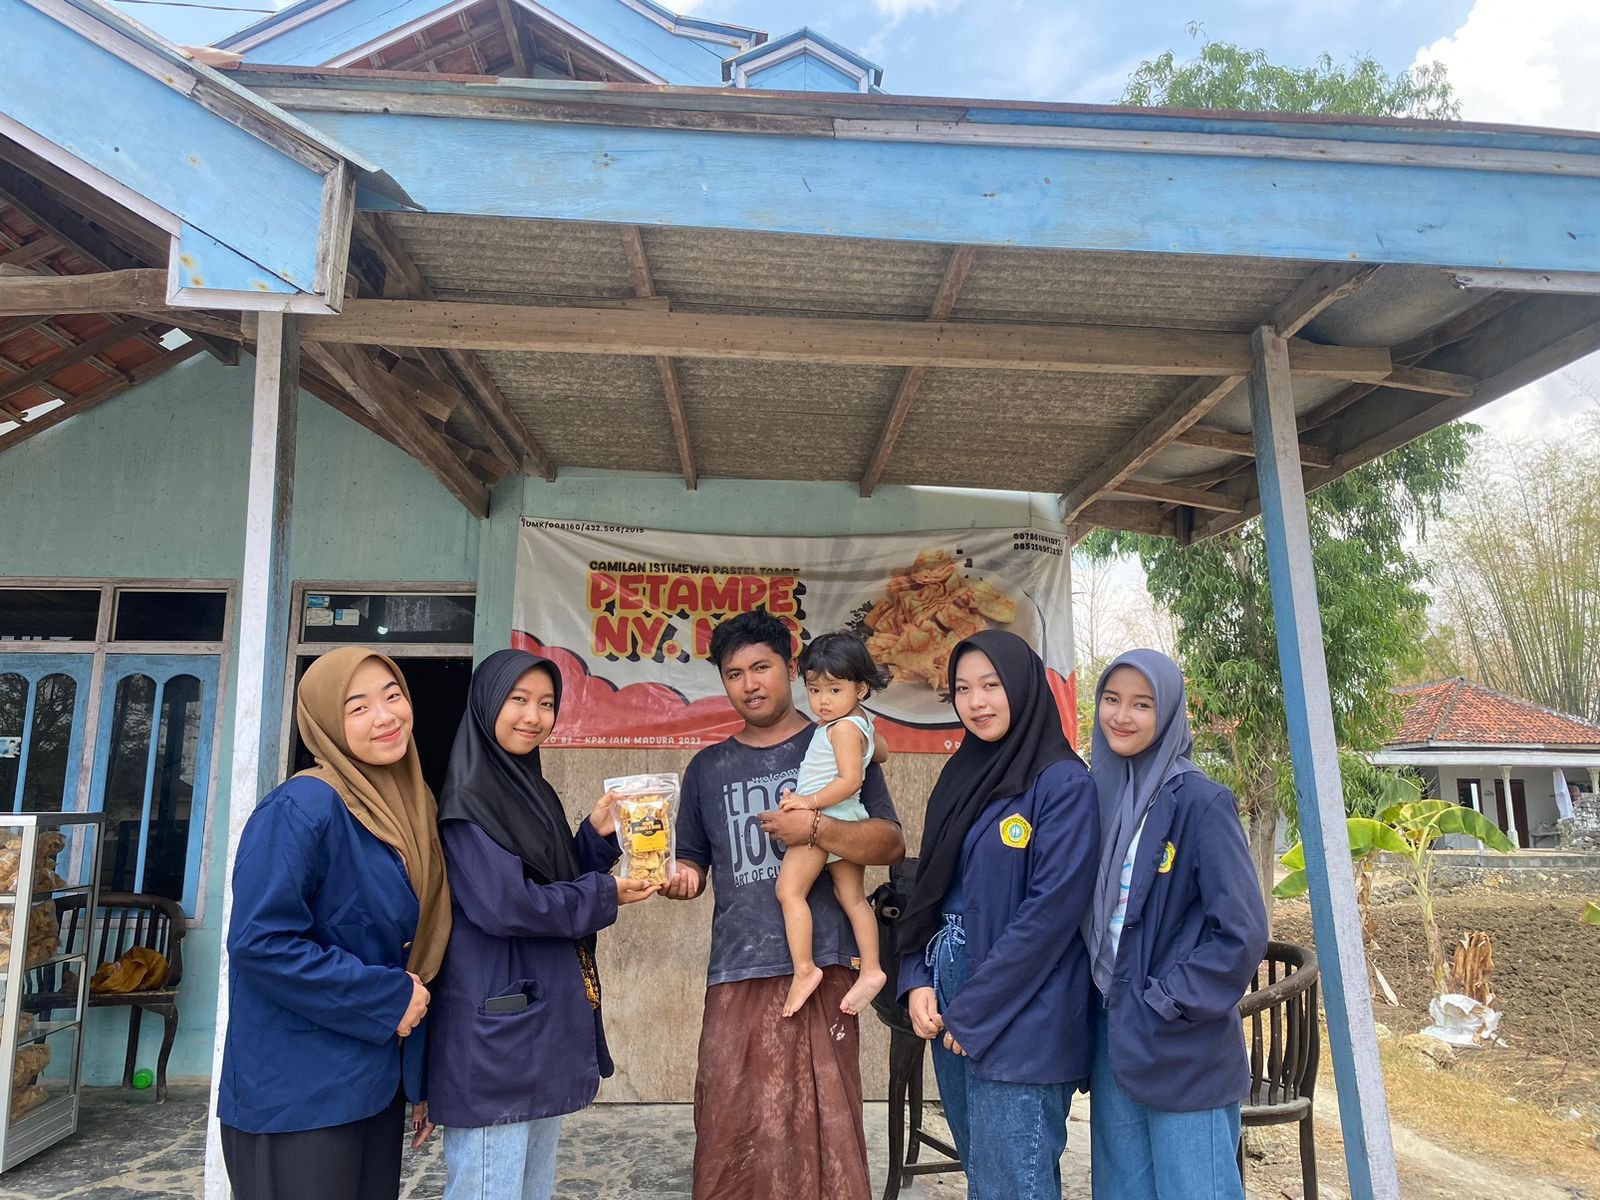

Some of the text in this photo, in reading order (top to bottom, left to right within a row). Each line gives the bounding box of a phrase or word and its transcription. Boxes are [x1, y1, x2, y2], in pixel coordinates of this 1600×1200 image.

[589, 560, 647, 572] CAMILAN
[649, 563, 710, 574] ISTIMEWA
[713, 566, 756, 575] PASTEL
[589, 572, 796, 612] PETAMPE
[594, 616, 679, 655] NY.
[585, 736, 606, 745] KPM
[634, 736, 675, 745] MADURA
[751, 868, 764, 881] OF
